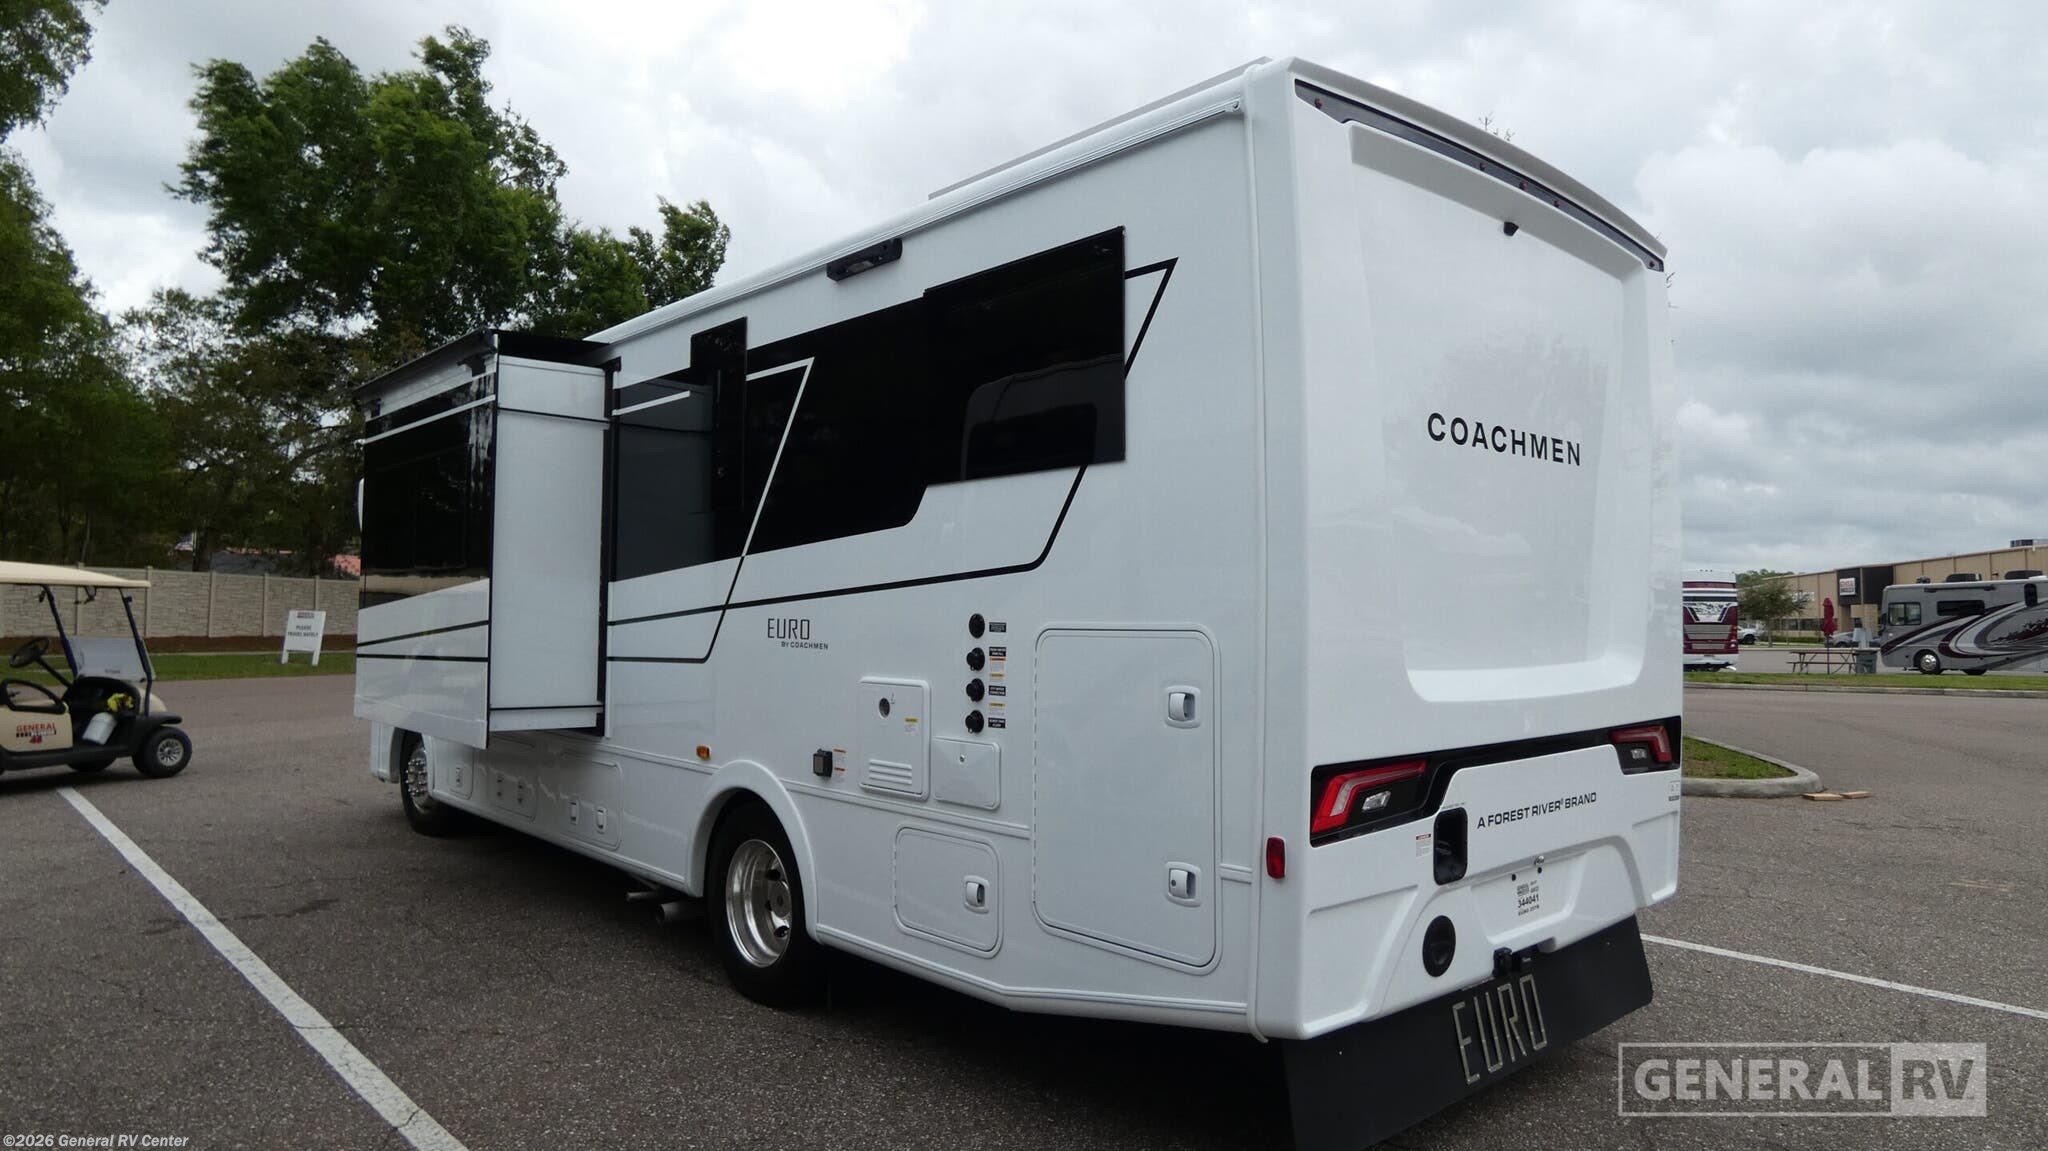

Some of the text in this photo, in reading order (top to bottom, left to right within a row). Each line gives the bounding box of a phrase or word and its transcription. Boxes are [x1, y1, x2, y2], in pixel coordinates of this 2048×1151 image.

[1427, 412, 1581, 466] COACHMEN
[767, 618, 810, 640] EURO
[790, 641, 829, 650] COACHMEN
[16, 722, 55, 732] GENERAL
[1477, 817, 1486, 829] A
[1487, 807, 1530, 827] FOREST
[1564, 792, 1597, 809] BRAND
[1452, 974, 1548, 1085] EURO
